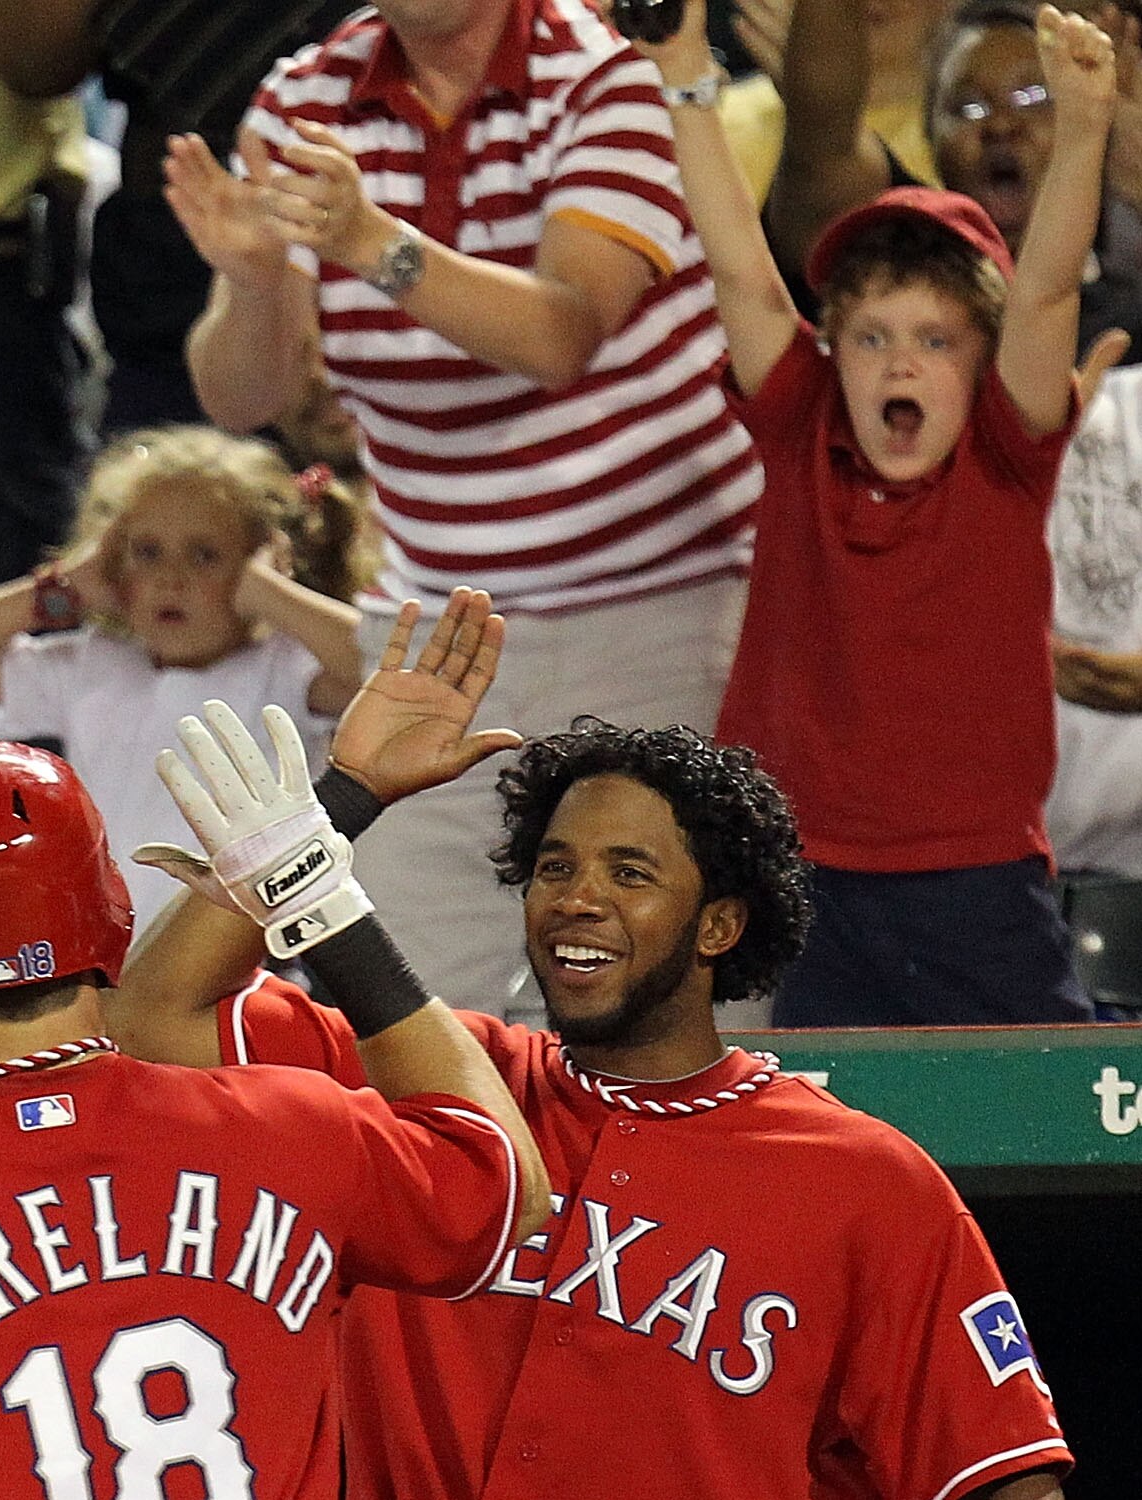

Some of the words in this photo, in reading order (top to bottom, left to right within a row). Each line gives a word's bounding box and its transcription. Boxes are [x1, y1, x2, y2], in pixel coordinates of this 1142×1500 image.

[18, 940, 55, 980] 18
[1092, 1066, 1142, 1135] t
[488, 1194, 797, 1395] EXAS
